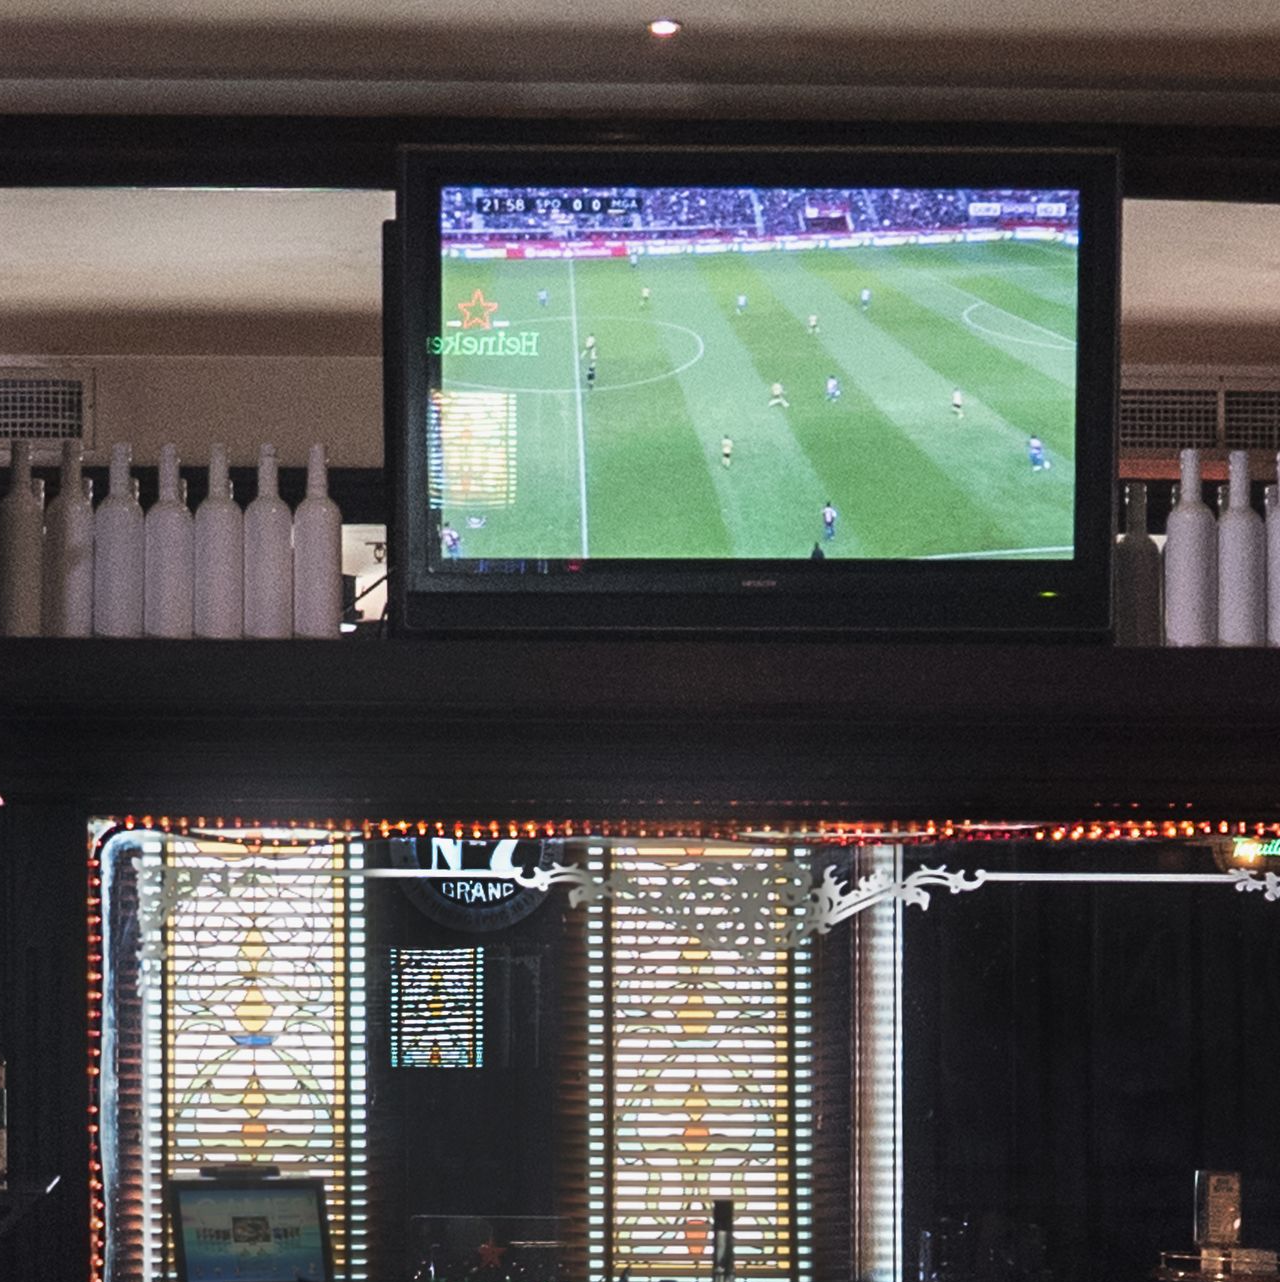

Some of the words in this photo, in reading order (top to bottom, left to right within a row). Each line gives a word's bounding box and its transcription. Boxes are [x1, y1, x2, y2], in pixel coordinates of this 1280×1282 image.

[482, 198, 525, 212] 21:58
[572, 199, 583, 211] 0
[591, 199, 601, 211] 0
